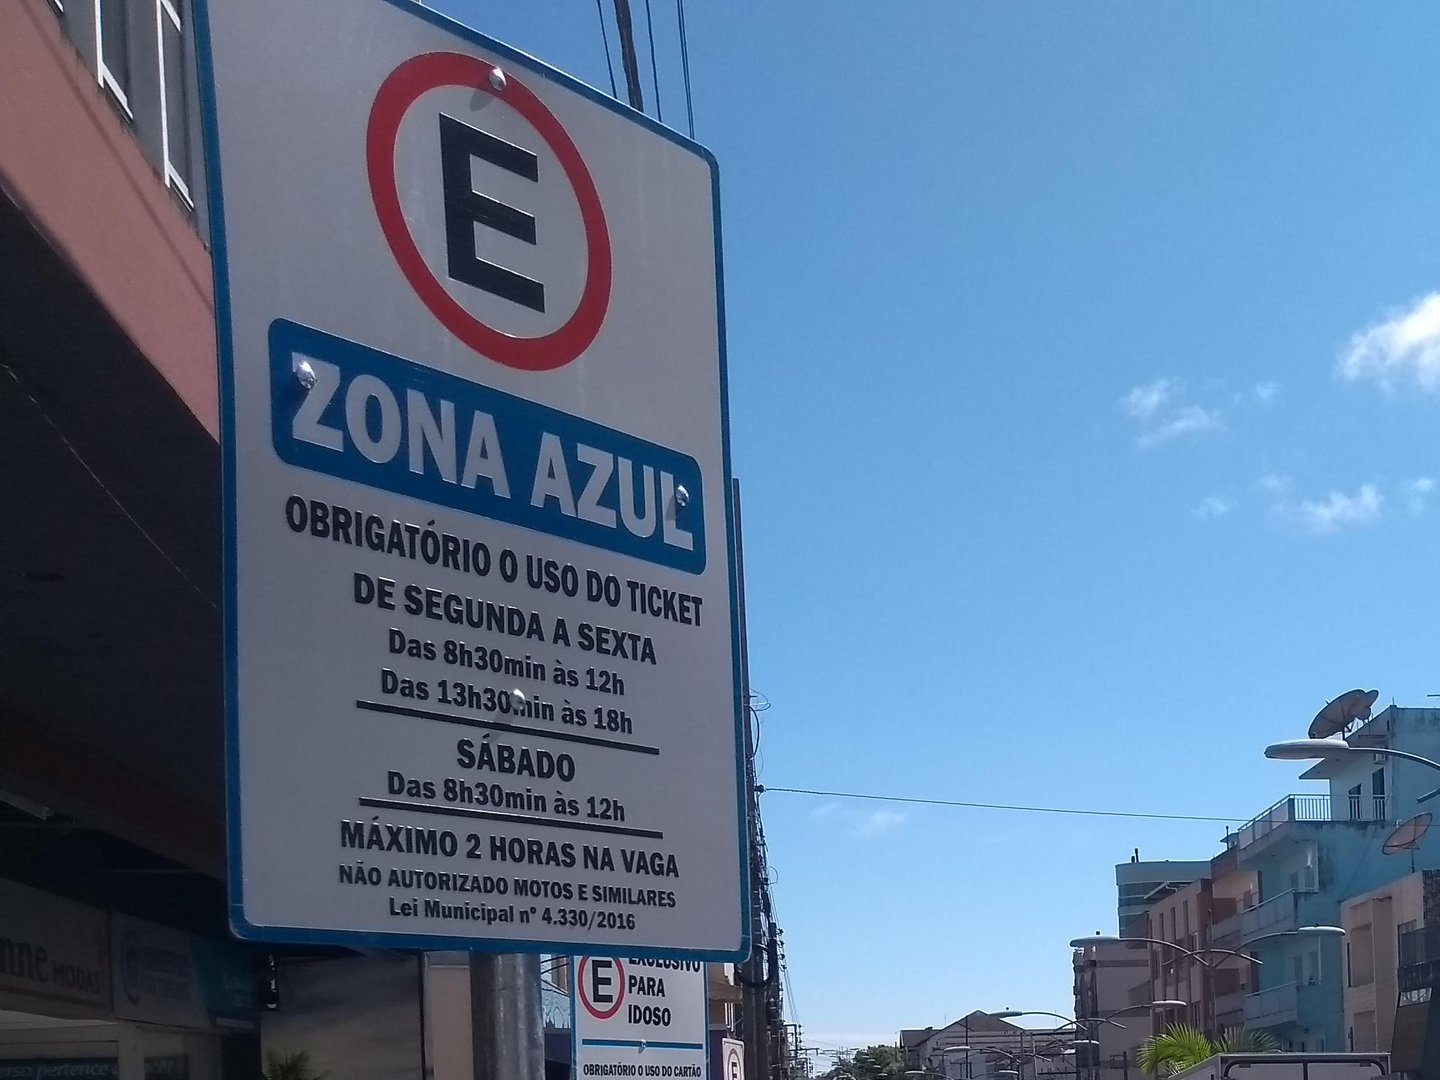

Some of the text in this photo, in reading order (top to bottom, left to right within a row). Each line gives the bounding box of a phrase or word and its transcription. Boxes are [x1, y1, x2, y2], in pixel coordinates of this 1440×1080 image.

[439, 112, 545, 313] E
[292, 352, 694, 551] ZONA AZUL
[286, 494, 703, 626] OBRIGATÓRIO O USO DO TICKET
[354, 572, 657, 665] DE SEGUNDA A SEXTA
[389, 628, 625, 696] Das 8h30min às 12h
[381, 668, 430, 700] Das
[561, 699, 587, 727] às
[594, 706, 633, 734] 18h
[457, 733, 576, 783] SÁBADO
[388, 770, 625, 822] Das 8h30min às 12h
[341, 815, 680, 887] MÁXIMO 2 HORAS NA VAGA
[339, 860, 676, 908] NÃO AUTORIZADO MOTOS E SIMILARES
[389, 896, 418, 917] Lei
[424, 898, 515, 925] Municipal
[542, 907, 636, 932] 4.330/2016
[592, 960, 613, 1003] E
[628, 975, 666, 997] PARA
[628, 1004, 671, 1026] IDOSO
[36, 1060, 109, 1080] pertence
[583, 1062, 701, 1078] OBRIGATÓRIO O USO DO CARTÃO
